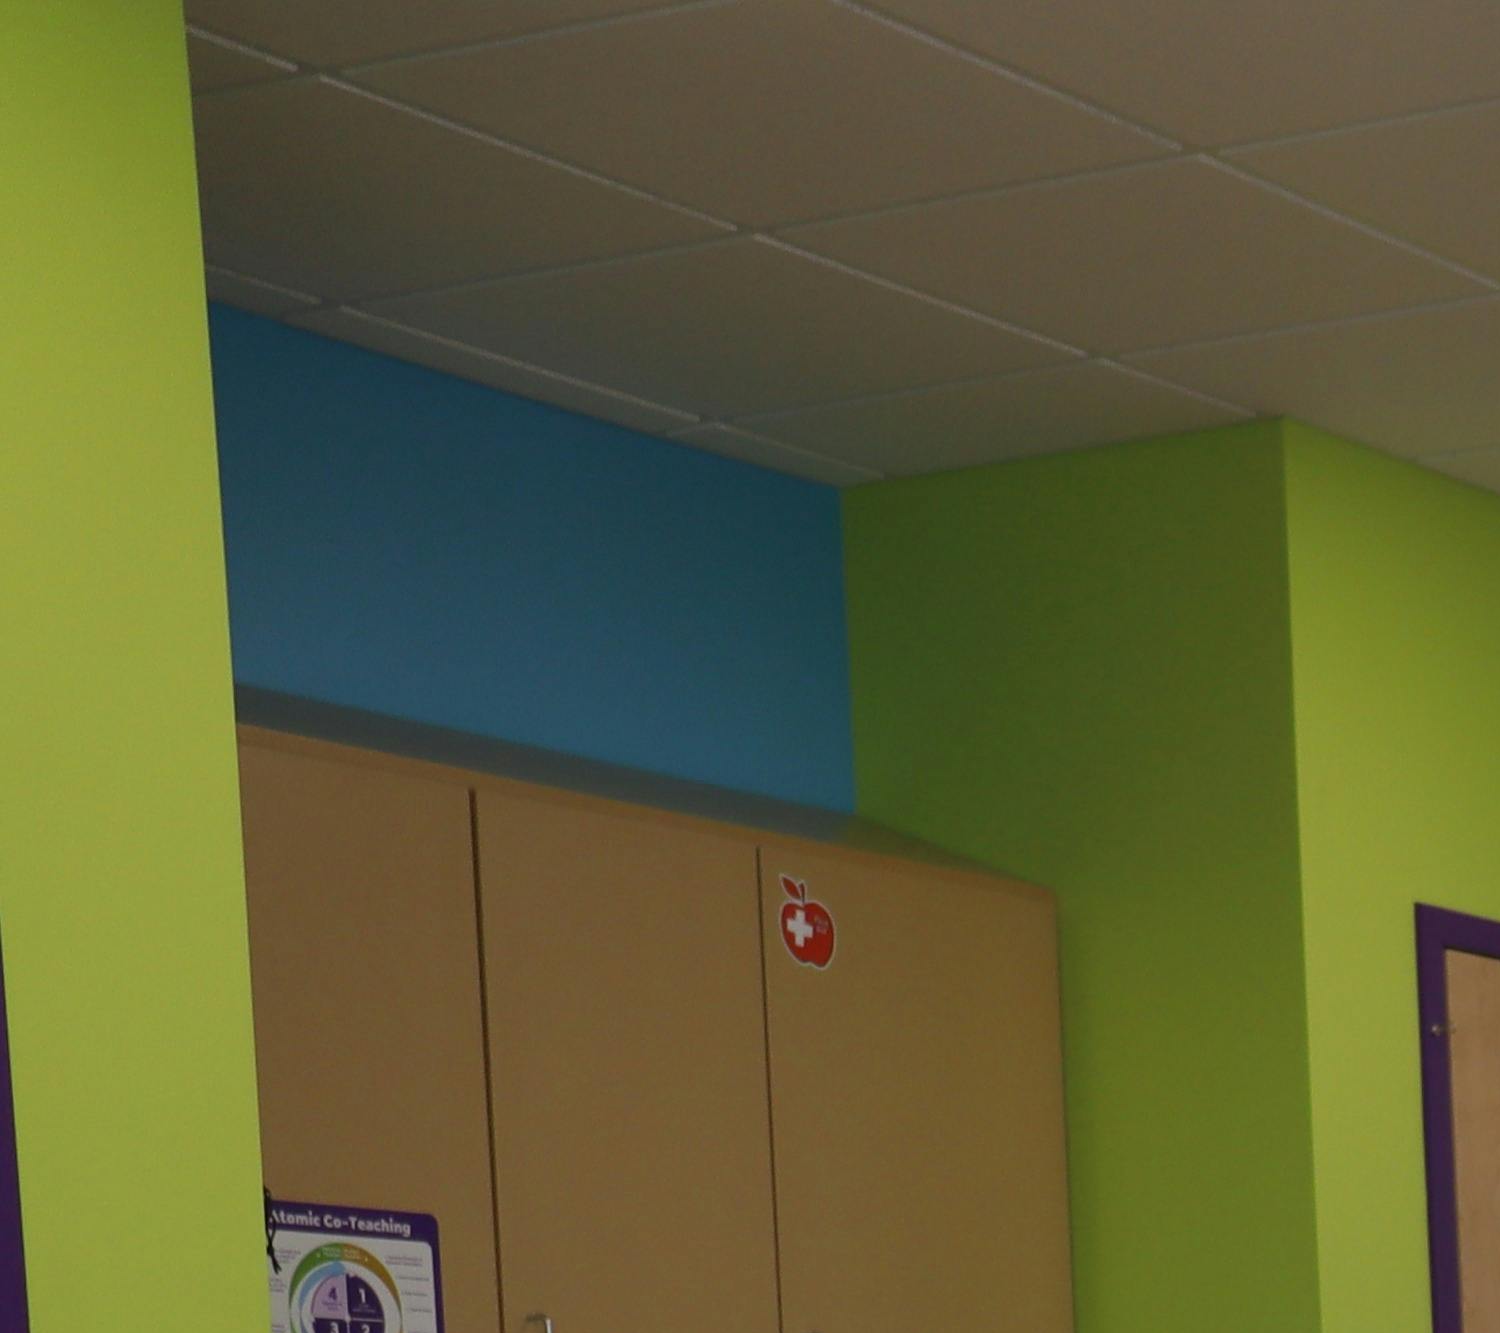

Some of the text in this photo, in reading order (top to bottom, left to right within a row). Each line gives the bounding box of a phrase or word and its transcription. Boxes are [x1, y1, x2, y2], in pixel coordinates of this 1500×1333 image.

[323, 1213, 411, 1238] Co-Teaching
[329, 1287, 338, 1300] 4
[359, 1288, 366, 1303] 1
